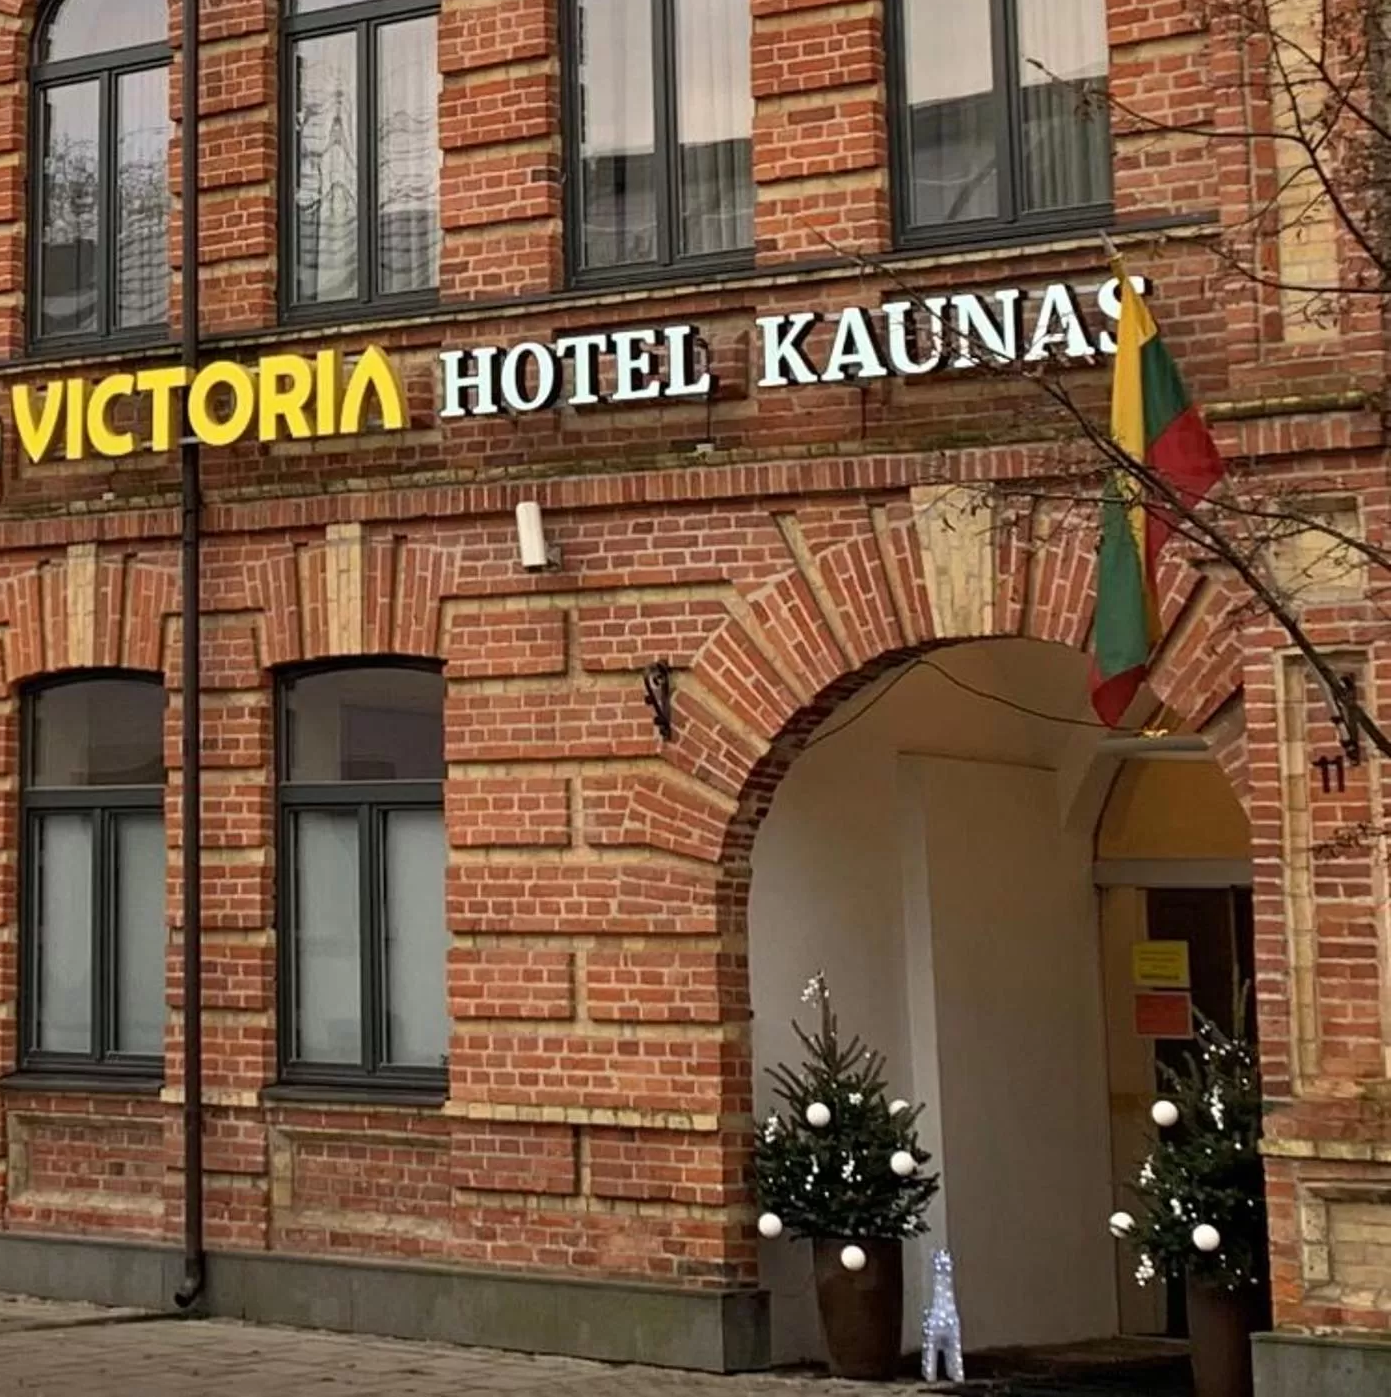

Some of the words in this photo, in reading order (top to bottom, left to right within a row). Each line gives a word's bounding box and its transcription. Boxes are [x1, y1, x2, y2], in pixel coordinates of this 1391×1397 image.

[12, 345, 406, 463] VICTORIA
[439, 325, 710, 417] HOTEL
[756, 275, 1146, 387] KAUNAS
[1312, 755, 1345, 793] 11
